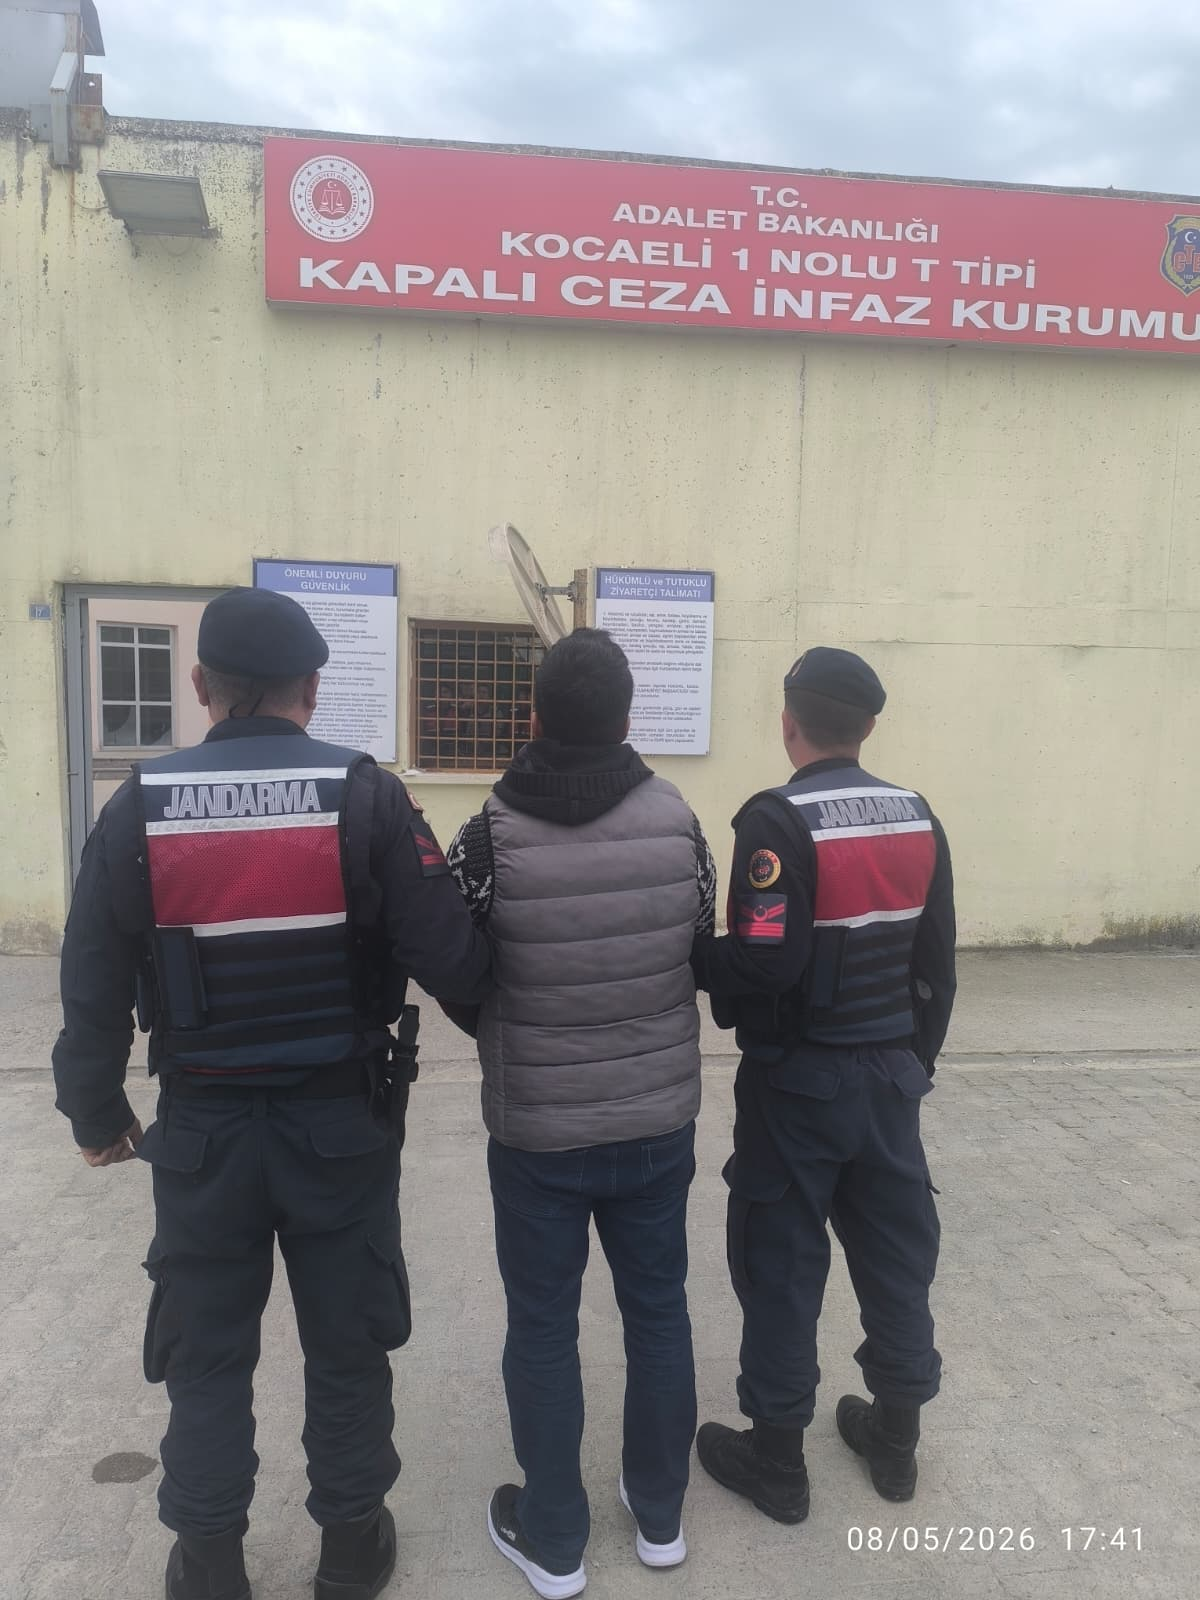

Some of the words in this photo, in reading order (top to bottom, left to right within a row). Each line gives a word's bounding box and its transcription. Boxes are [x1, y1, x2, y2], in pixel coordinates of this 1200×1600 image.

[750, 185, 808, 209] T.C.
[612, 202, 748, 230] ADALET
[758, 212, 939, 243] BAKANLIĞI
[501, 231, 712, 269] KOCAELİ
[731, 248, 749, 271] 1
[770, 249, 897, 280] NOLU
[911, 258, 940, 282] T
[952, 256, 1036, 289] TİPİ
[299, 257, 536, 303] KAPALI
[560, 275, 732, 315] CEZA
[753, 278, 932, 326] İNFAZ
[951, 299, 1200, 342] KURUMU
[284, 567, 323, 579] ÖNEMLİ
[325, 570, 367, 581] DUYURU
[300, 579, 351, 592] GÜVENLİK
[604, 574, 651, 586] HÜKÜMLÜ
[653, 578, 663, 586] ve
[665, 577, 707, 588] TUTUKLU
[610, 586, 657, 599] ZİYARETÇİ
[660, 587, 701, 599] TALİMATI
[163, 780, 322, 819] JANDARMA
[818, 797, 920, 829] JANDARMA
